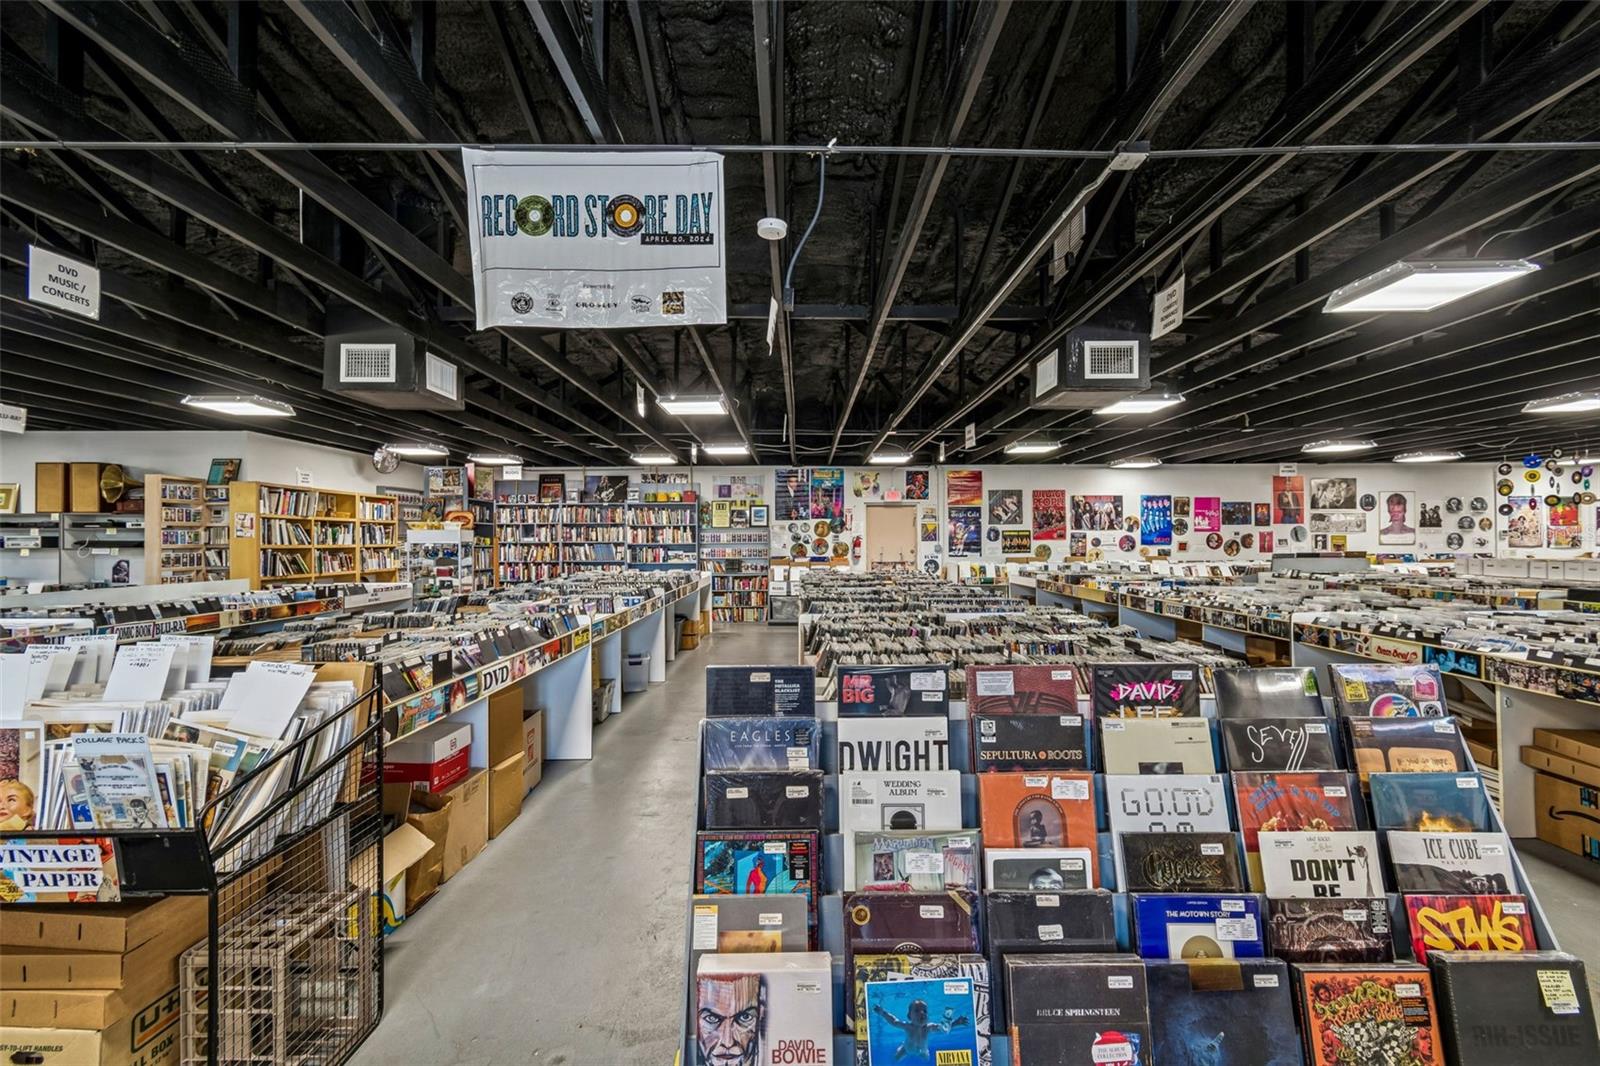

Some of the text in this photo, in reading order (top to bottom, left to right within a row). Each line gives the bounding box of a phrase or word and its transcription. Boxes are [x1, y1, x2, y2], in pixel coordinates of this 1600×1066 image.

[481, 192, 713, 237] RECORD STORE DAY
[57, 264, 79, 278] DVD
[48, 273, 80, 291] MUSIC
[42, 285, 90, 307] CONCERTS
[115, 620, 188, 640] COMIC BOOK BLU-RAY
[482, 664, 510, 690] DVD
[842, 688, 875, 704] BIG
[1119, 682, 1176, 701] DAVID
[75, 736, 146, 745] COLLAGE PACKS
[730, 729, 792, 742] EAGLES
[838, 740, 949, 774] DWIGHT
[980, 749, 1083, 760] SEPULTURA ROOTS
[883, 780, 922, 788] WEDDING
[888, 788, 918, 796] ALBUM
[1423, 838, 1482, 860] ICE CUBE
[1290, 859, 1355, 881] DON'T
[22, 873, 99, 887] PAPER
[1064, 1008, 1121, 1016] SPRINGSTEEN
[151, 1034, 174, 1057] BOX
[778, 1039, 815, 1051] DAVID
[771, 1048, 826, 1064] BOWIE
[938, 1051, 970, 1064] NIRVANA
